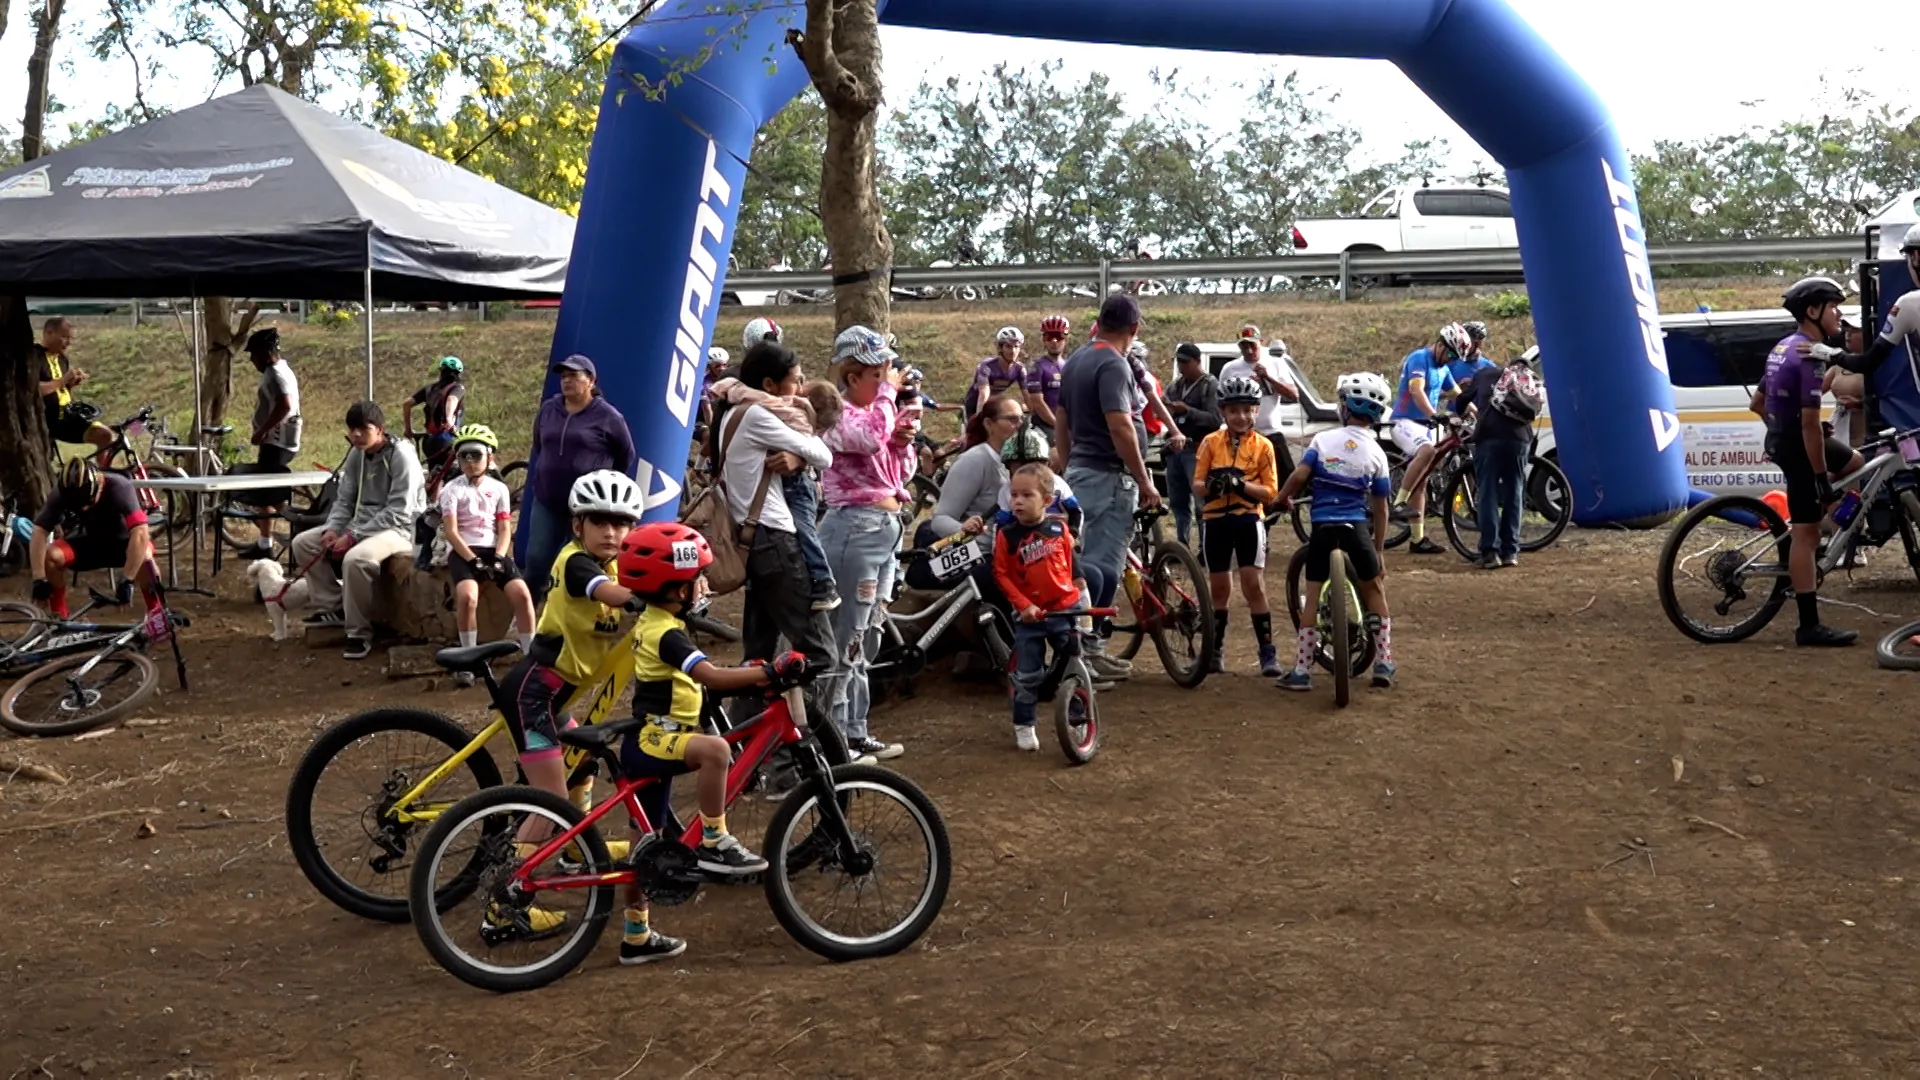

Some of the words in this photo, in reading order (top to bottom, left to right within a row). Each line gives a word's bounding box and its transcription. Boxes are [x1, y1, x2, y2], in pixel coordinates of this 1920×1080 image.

[1601, 157, 1669, 376] GIANT
[666, 139, 731, 427] GIANT
[1702, 451, 1717, 466] DE
[1727, 473, 1743, 485] DE
[676, 546, 697, 562] 166
[941, 545, 970, 570] 069
